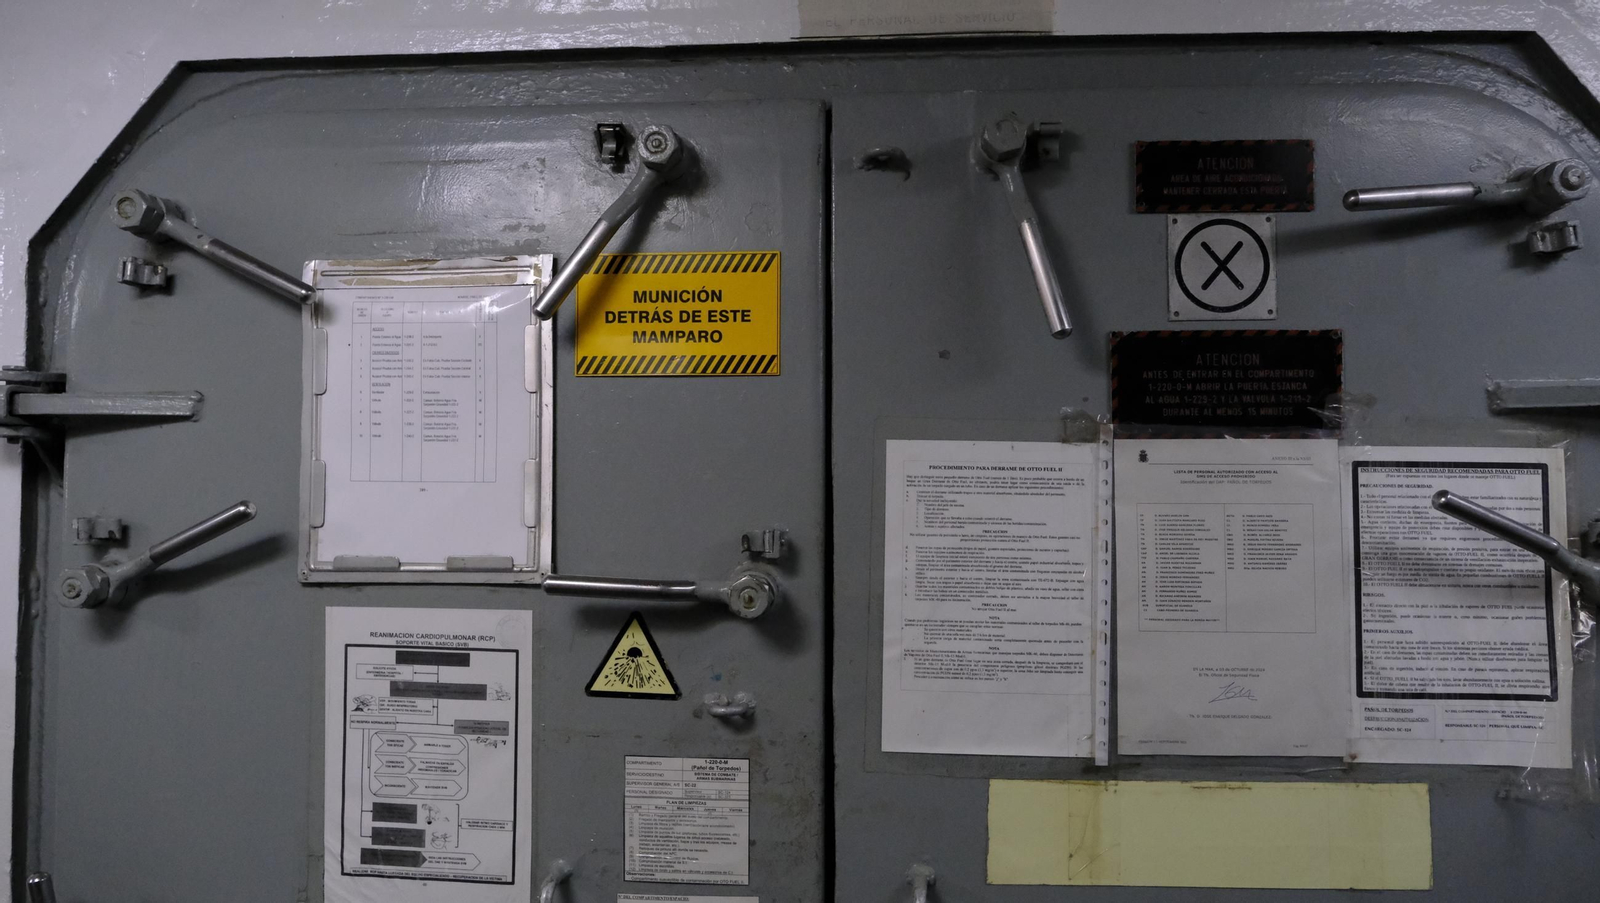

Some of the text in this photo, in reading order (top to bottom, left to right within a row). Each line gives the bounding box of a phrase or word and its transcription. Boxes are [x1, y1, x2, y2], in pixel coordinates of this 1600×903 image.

[1197, 157, 1254, 170] ATENCION
[1170, 174, 1189, 183] AREA
[1192, 174, 1202, 183] DE
[1205, 174, 1221, 183] AIRE
[1163, 186, 1288, 195] MANTENER CERRADA ESTA PUERTA
[632, 286, 723, 303] MUNICIÓN
[605, 307, 752, 323] DETRÁS DE ESTE
[632, 330, 723, 343] MAMPARO
[1196, 353, 1260, 365] ATENCION
[1143, 370, 1315, 379] ANTES DE ENTRAR EN EL COMPARTIMENTO
[1149, 382, 1308, 392] 1-220-0-M ABRIR LA PUERTA ESTANCA
[1145, 396, 1155, 405] AL
[1159, 395, 1180, 404] AGUA
[1220, 395, 1226, 403] Y
[1229, 395, 1239, 404] LA
[1242, 394, 1276, 403] VALVULA
[1163, 407, 1200, 417] DURANTE
[1203, 407, 1214, 416] AL
[1217, 407, 1243, 416] MENOS
[1260, 407, 1294, 416] MINUTOS
[370, 631, 496, 643] REANIMACION CARDIOPULMONAR (RCP)
